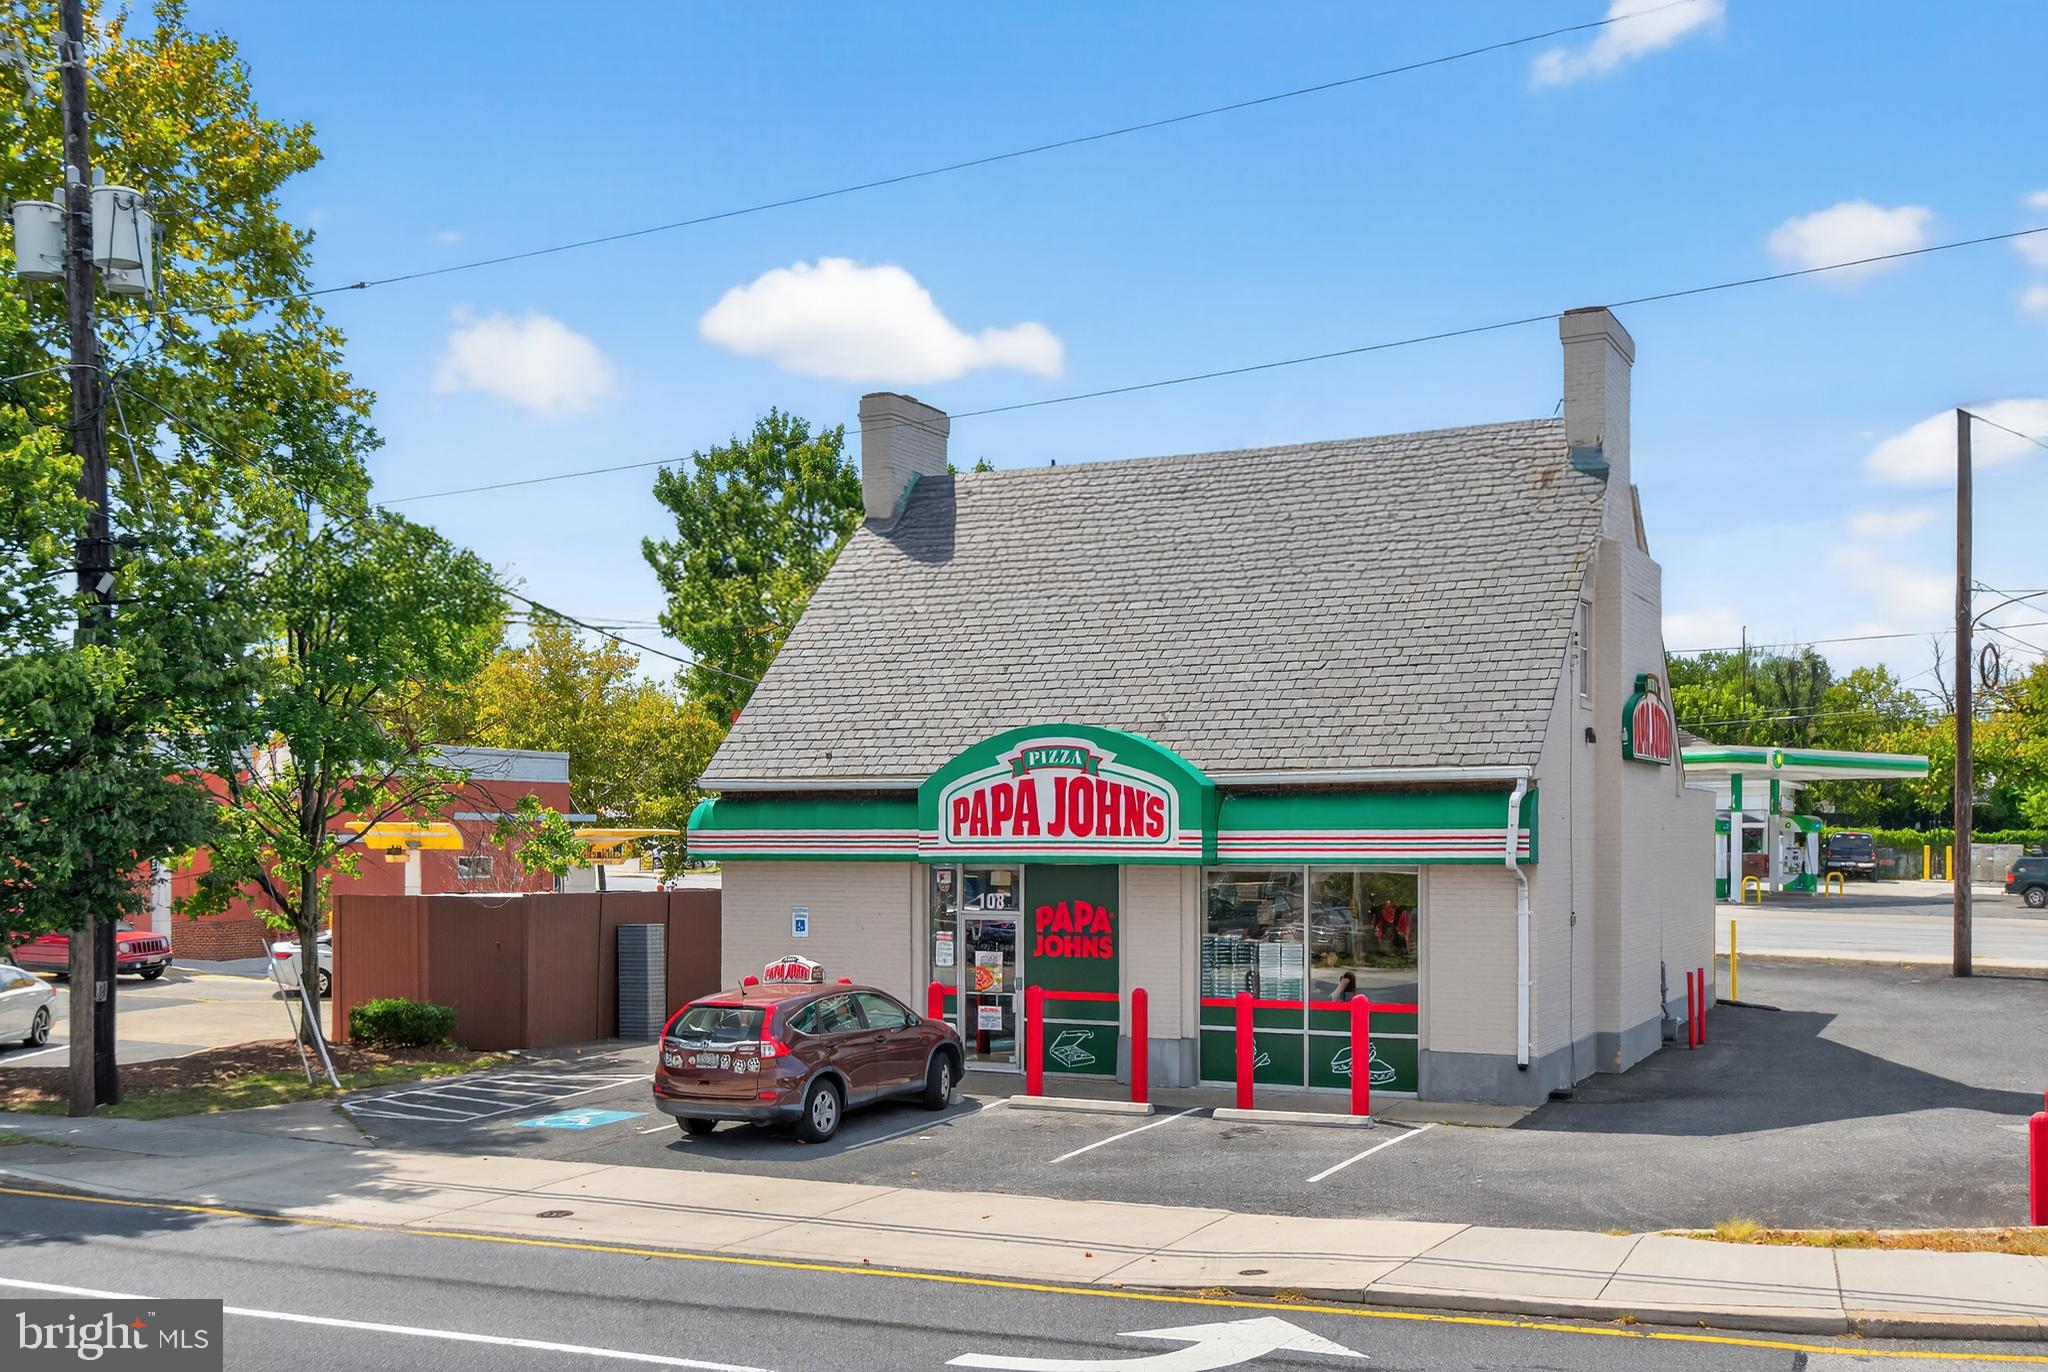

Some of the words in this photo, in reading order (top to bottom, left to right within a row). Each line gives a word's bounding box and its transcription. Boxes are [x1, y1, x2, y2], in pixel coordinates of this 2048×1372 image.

[1028, 750, 1083, 766] PIZZA
[953, 778, 1041, 837] PAPA
[979, 892, 1005, 910] 108
[1035, 900, 1113, 934] PAPA
[1033, 934, 1114, 959] JOHNS
